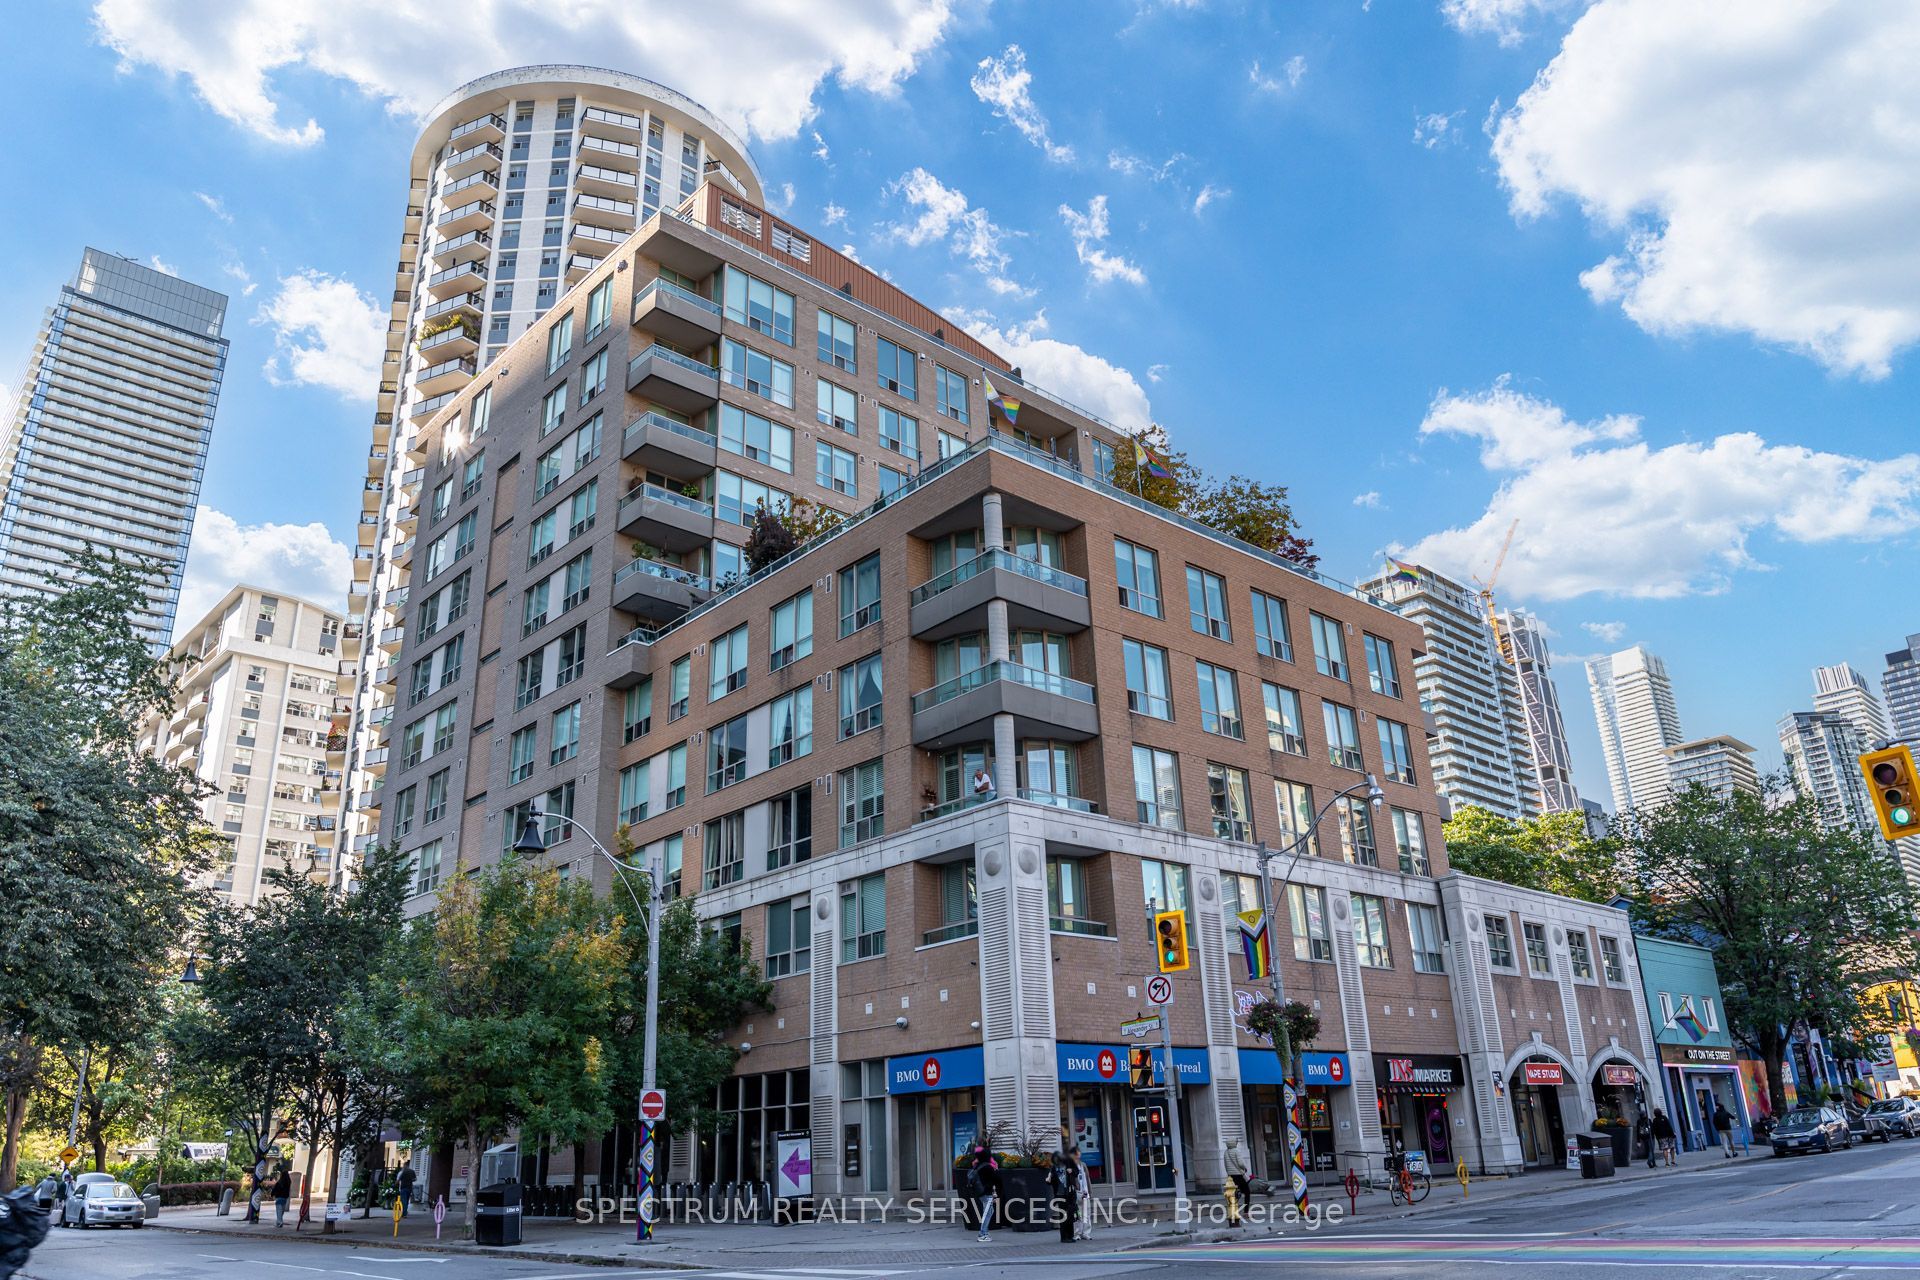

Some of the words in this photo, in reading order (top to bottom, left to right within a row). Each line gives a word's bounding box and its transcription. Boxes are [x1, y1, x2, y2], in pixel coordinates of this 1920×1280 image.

[1127, 1024, 1149, 1034] Alexander
[1687, 1049, 1698, 1059] OUT
[1698, 1050, 1706, 1060] ON
[1706, 1050, 1715, 1060] THE
[1715, 1051, 1731, 1061] STREET
[1067, 1058, 1094, 1071] BMO
[1160, 1061, 1201, 1073] Mtreal
[1307, 1064, 1328, 1075] BMO
[1387, 1059, 1414, 1082] INS
[1414, 1069, 1452, 1082] MARKET
[896, 1069, 920, 1083] BMO
[1527, 1069, 1541, 1079] VAPE
[1542, 1069, 1560, 1079] STUDIO
